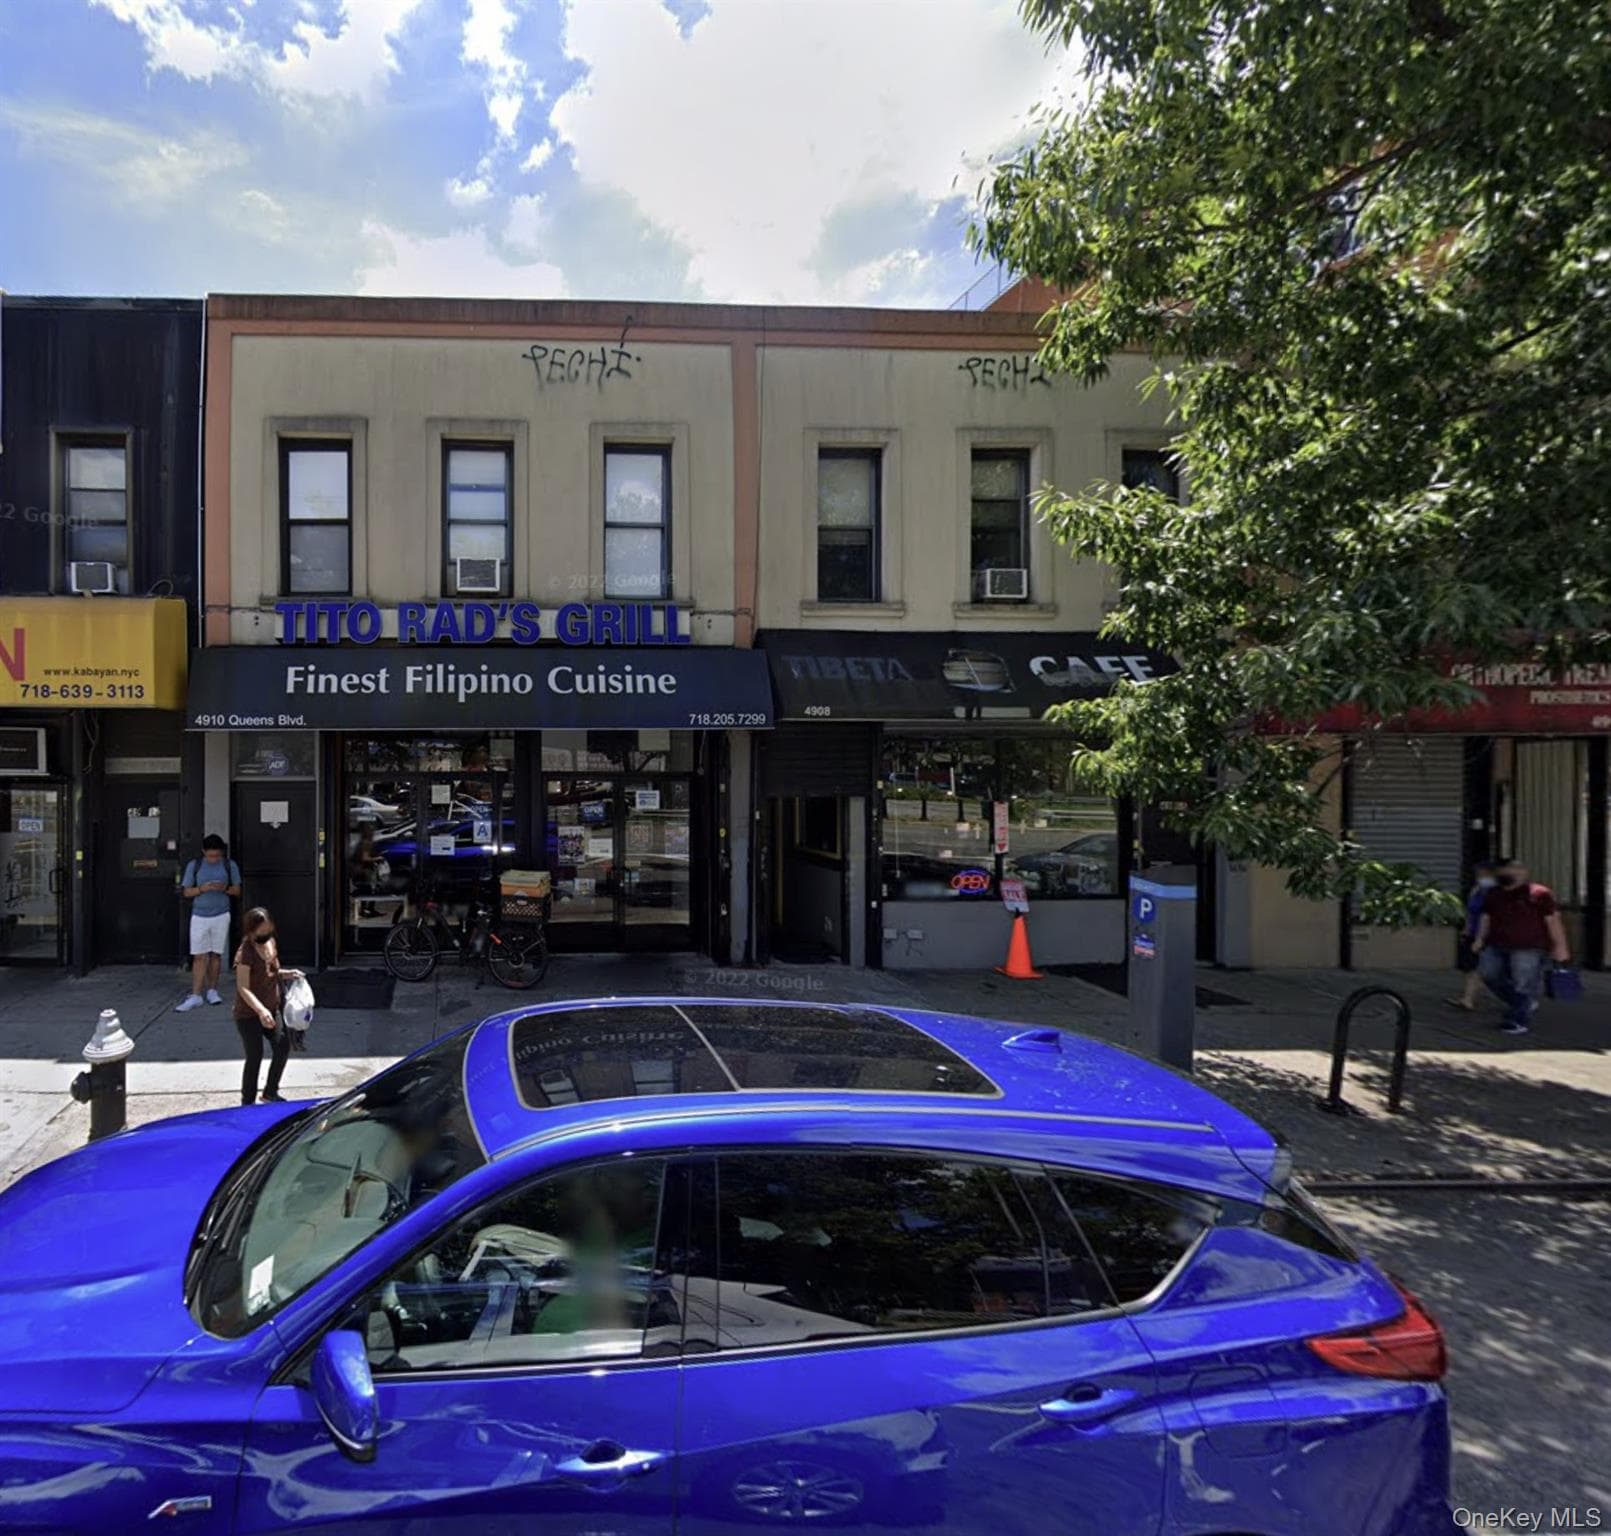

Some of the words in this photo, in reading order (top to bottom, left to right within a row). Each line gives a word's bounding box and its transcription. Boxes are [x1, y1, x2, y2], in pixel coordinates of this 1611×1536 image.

[275, 602, 383, 644] TITO
[398, 602, 541, 645] RAD'S
[555, 603, 691, 645] GRILL
[43, 667, 140, 678] www.kabayan.nyc
[286, 664, 390, 694] Finest
[405, 664, 533, 703] Filipino
[547, 664, 677, 695] Cuisine
[20, 684, 145, 698] 718-639-3113
[804, 706, 831, 717] 4908
[195, 714, 225, 726] 4910
[229, 714, 275, 726] Queens
[278, 714, 307, 726] Blvd.
[689, 713, 766, 726] 718.205.7299
[951, 874, 989, 891] OPEN
[1140, 898, 1153, 919] P
